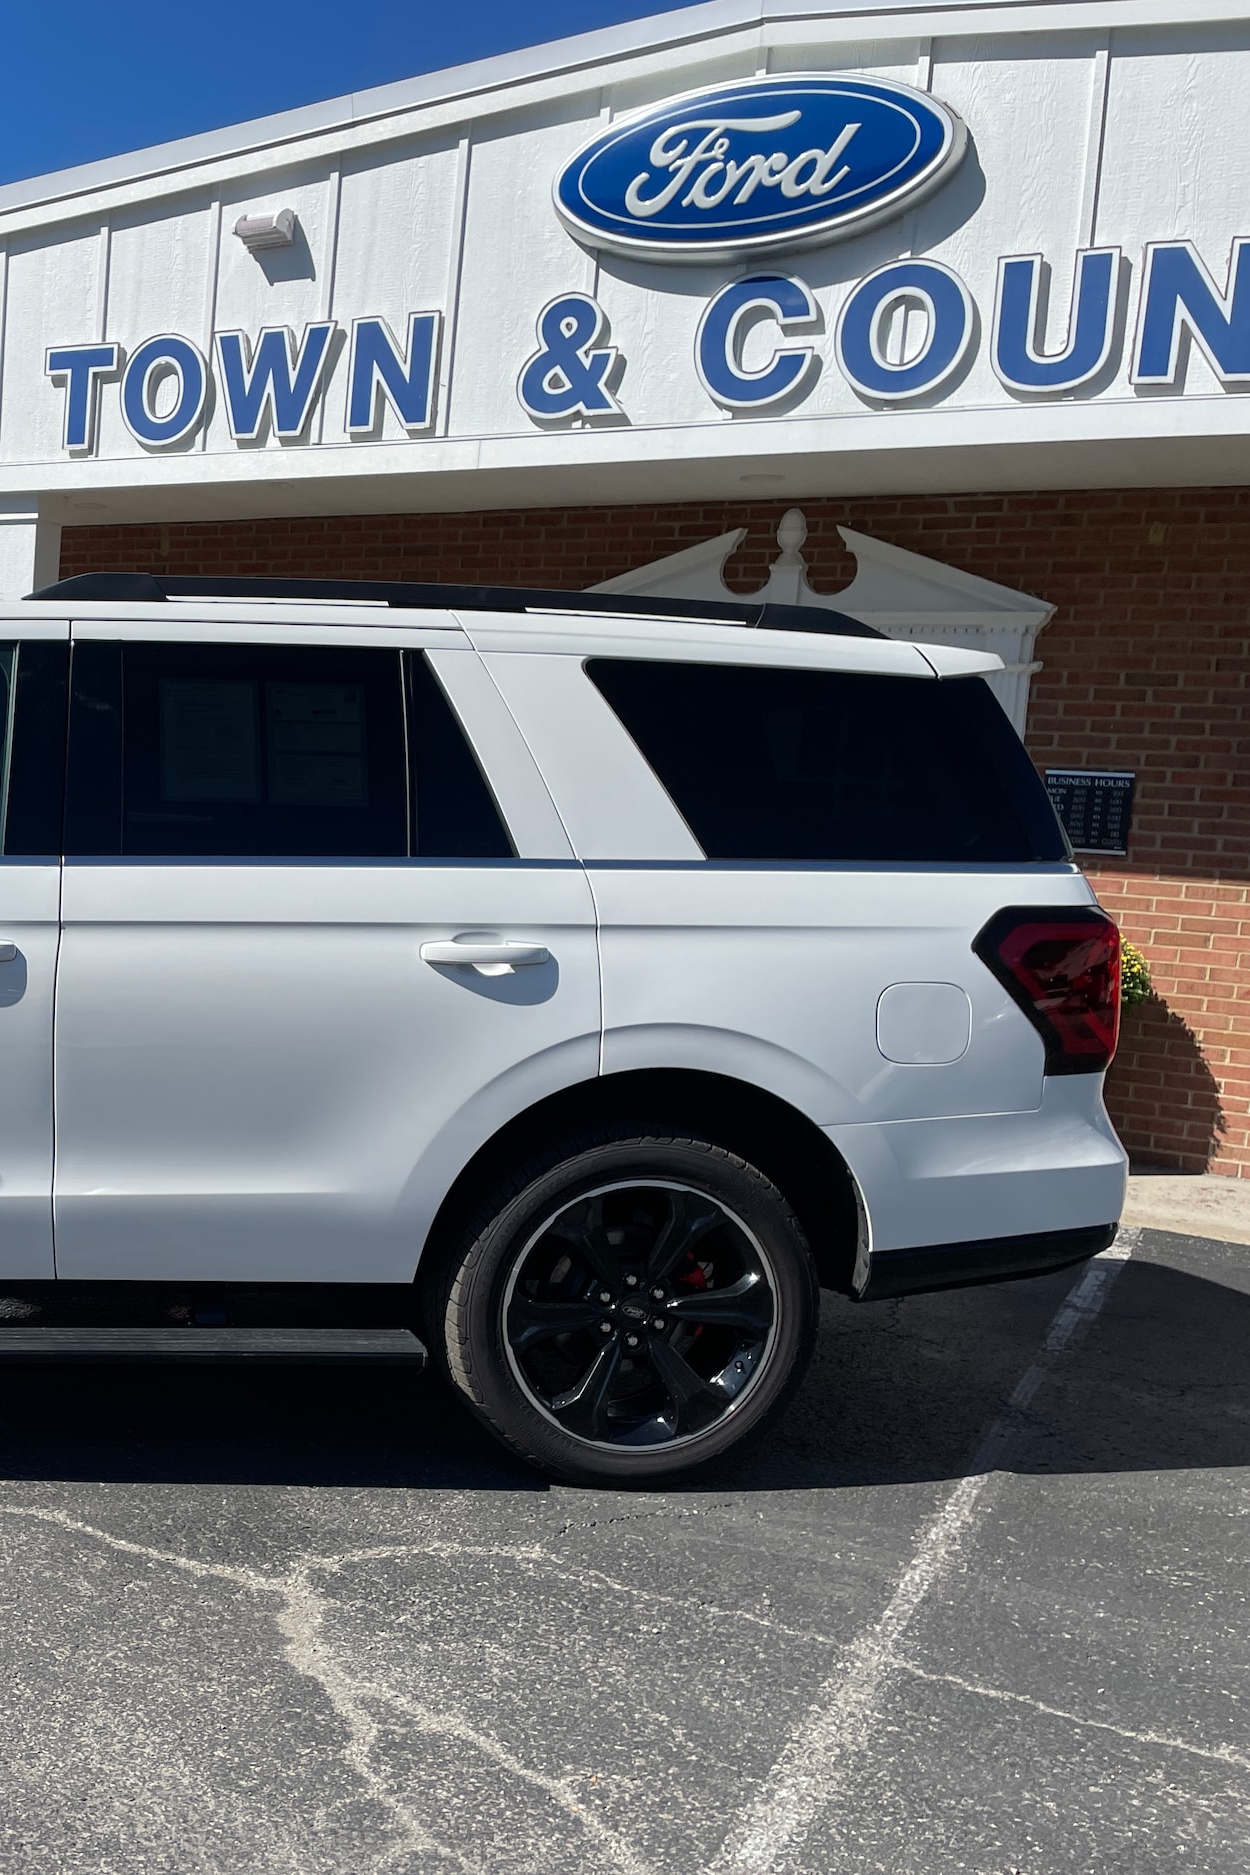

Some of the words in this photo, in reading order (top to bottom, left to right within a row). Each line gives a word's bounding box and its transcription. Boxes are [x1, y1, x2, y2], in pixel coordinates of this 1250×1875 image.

[625, 109, 861, 217] Ford
[45, 309, 442, 450] TOWN
[516, 291, 623, 419] &
[1047, 777, 1091, 786] BUSINESS
[1094, 779, 1131, 788] HOURS
